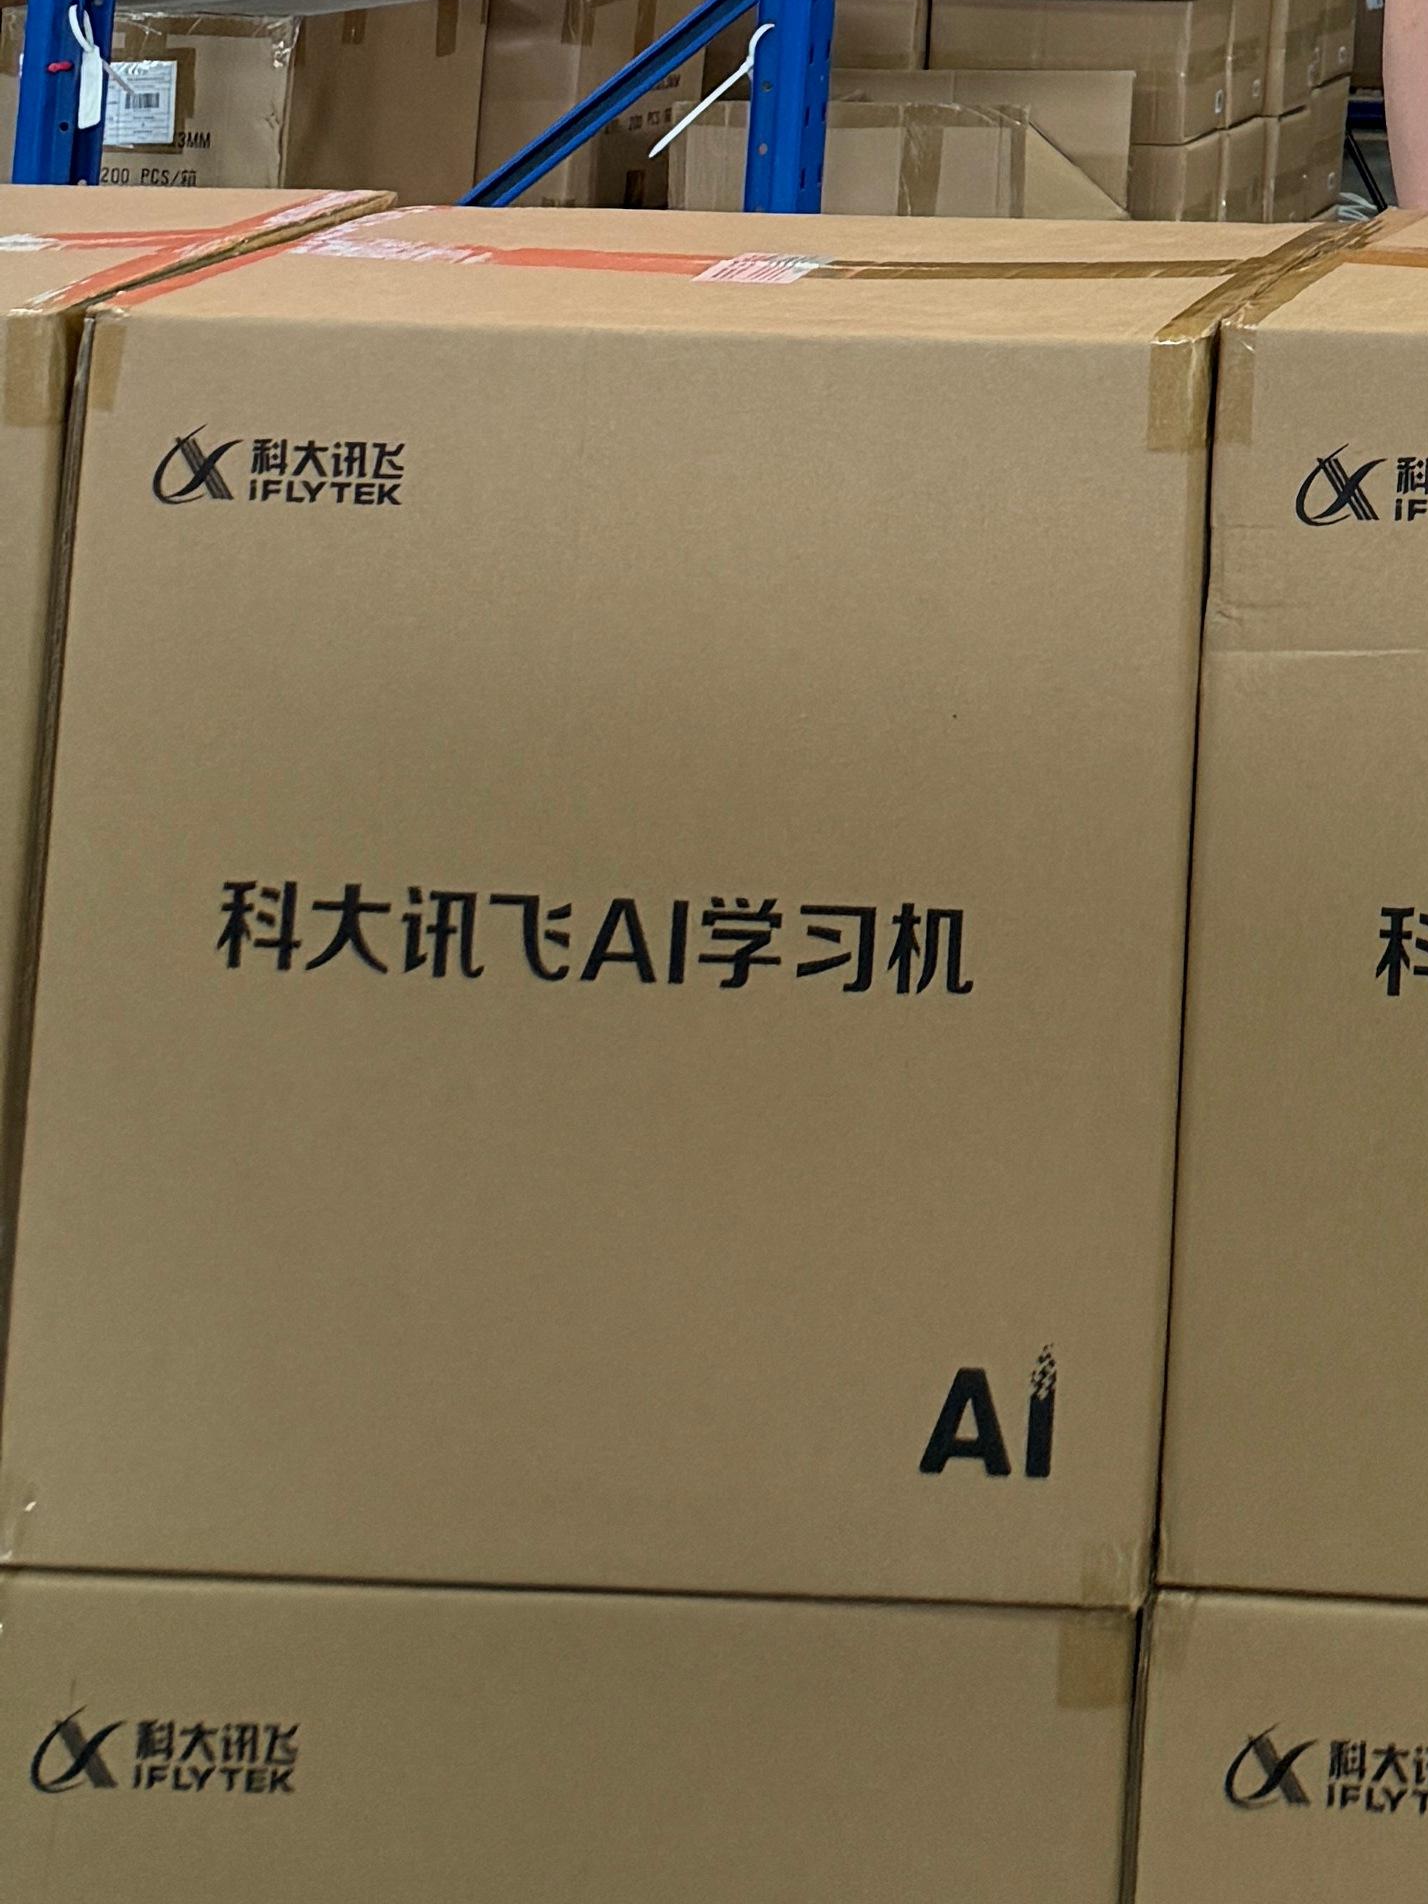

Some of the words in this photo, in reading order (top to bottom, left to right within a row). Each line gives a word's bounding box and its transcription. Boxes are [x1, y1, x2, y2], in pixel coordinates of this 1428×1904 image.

[250, 436, 405, 481] 科大讯飞
[249, 478, 403, 507] iFLYTEK
[217, 882, 973, 994] 科大讯飞AI学习机
[136, 1721, 300, 1764] 科大讯飞
